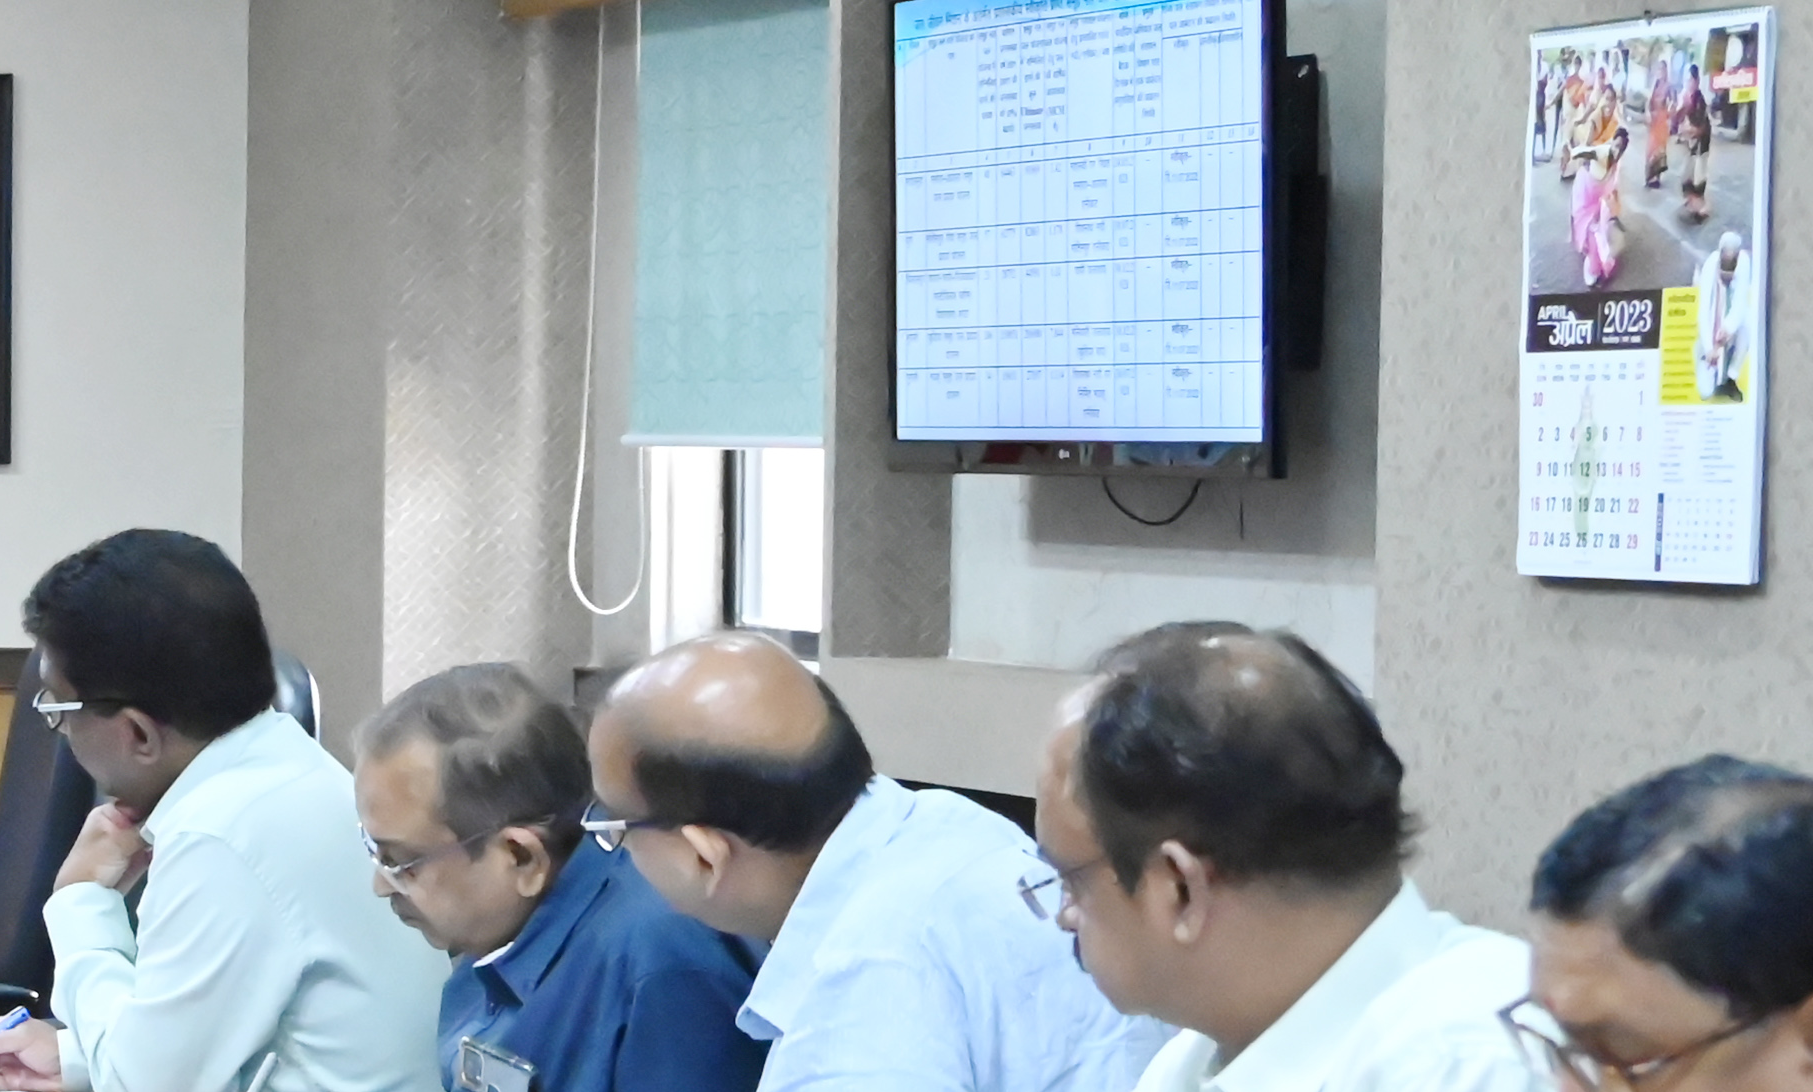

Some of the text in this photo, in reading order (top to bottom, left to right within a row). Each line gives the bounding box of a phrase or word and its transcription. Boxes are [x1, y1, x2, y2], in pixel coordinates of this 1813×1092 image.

[1537, 299, 1653, 334] APRIL 2023
[1586, 426, 1592, 442] 5
